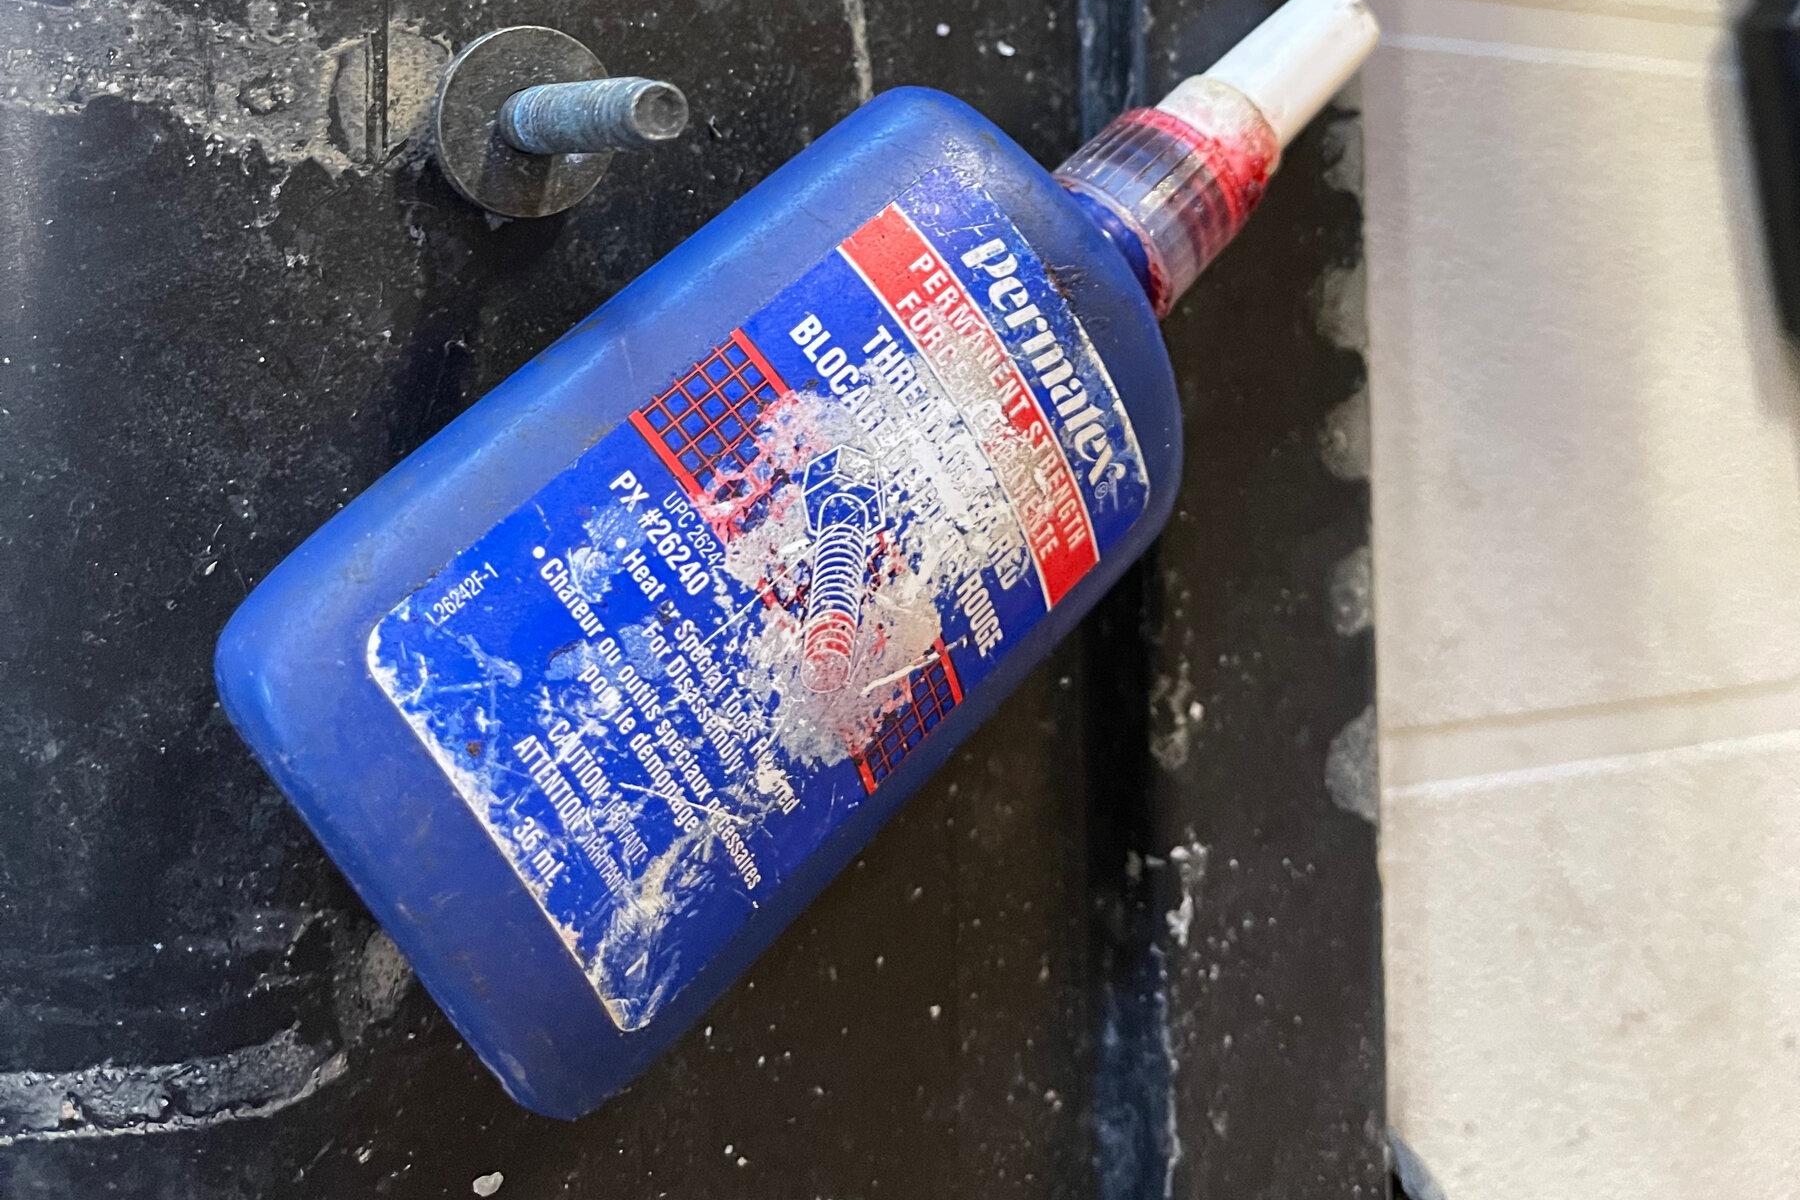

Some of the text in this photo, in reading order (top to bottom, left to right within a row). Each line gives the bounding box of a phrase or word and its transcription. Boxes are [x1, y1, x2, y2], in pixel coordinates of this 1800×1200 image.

[908, 252, 1087, 552] PERMANENT STRENGTH
[959, 236, 1128, 486] Permatex
[608, 469, 710, 597] PX #26240
[663, 490, 727, 573] UPC 26242
[787, 313, 896, 449] BLOCAGE
[956, 573, 1004, 656] ROUGE
[961, 387, 1061, 559] ERMANENTE
[621, 548, 668, 601] Heat
[673, 619, 733, 696] Special
[640, 619, 746, 774] For Disassembly
[578, 664, 623, 712] pou
[613, 707, 637, 736] le
[597, 636, 625, 668] ou
[616, 664, 663, 722] outils
[653, 718, 713, 803] spéciaux
[510, 815, 565, 888] 36 mL
